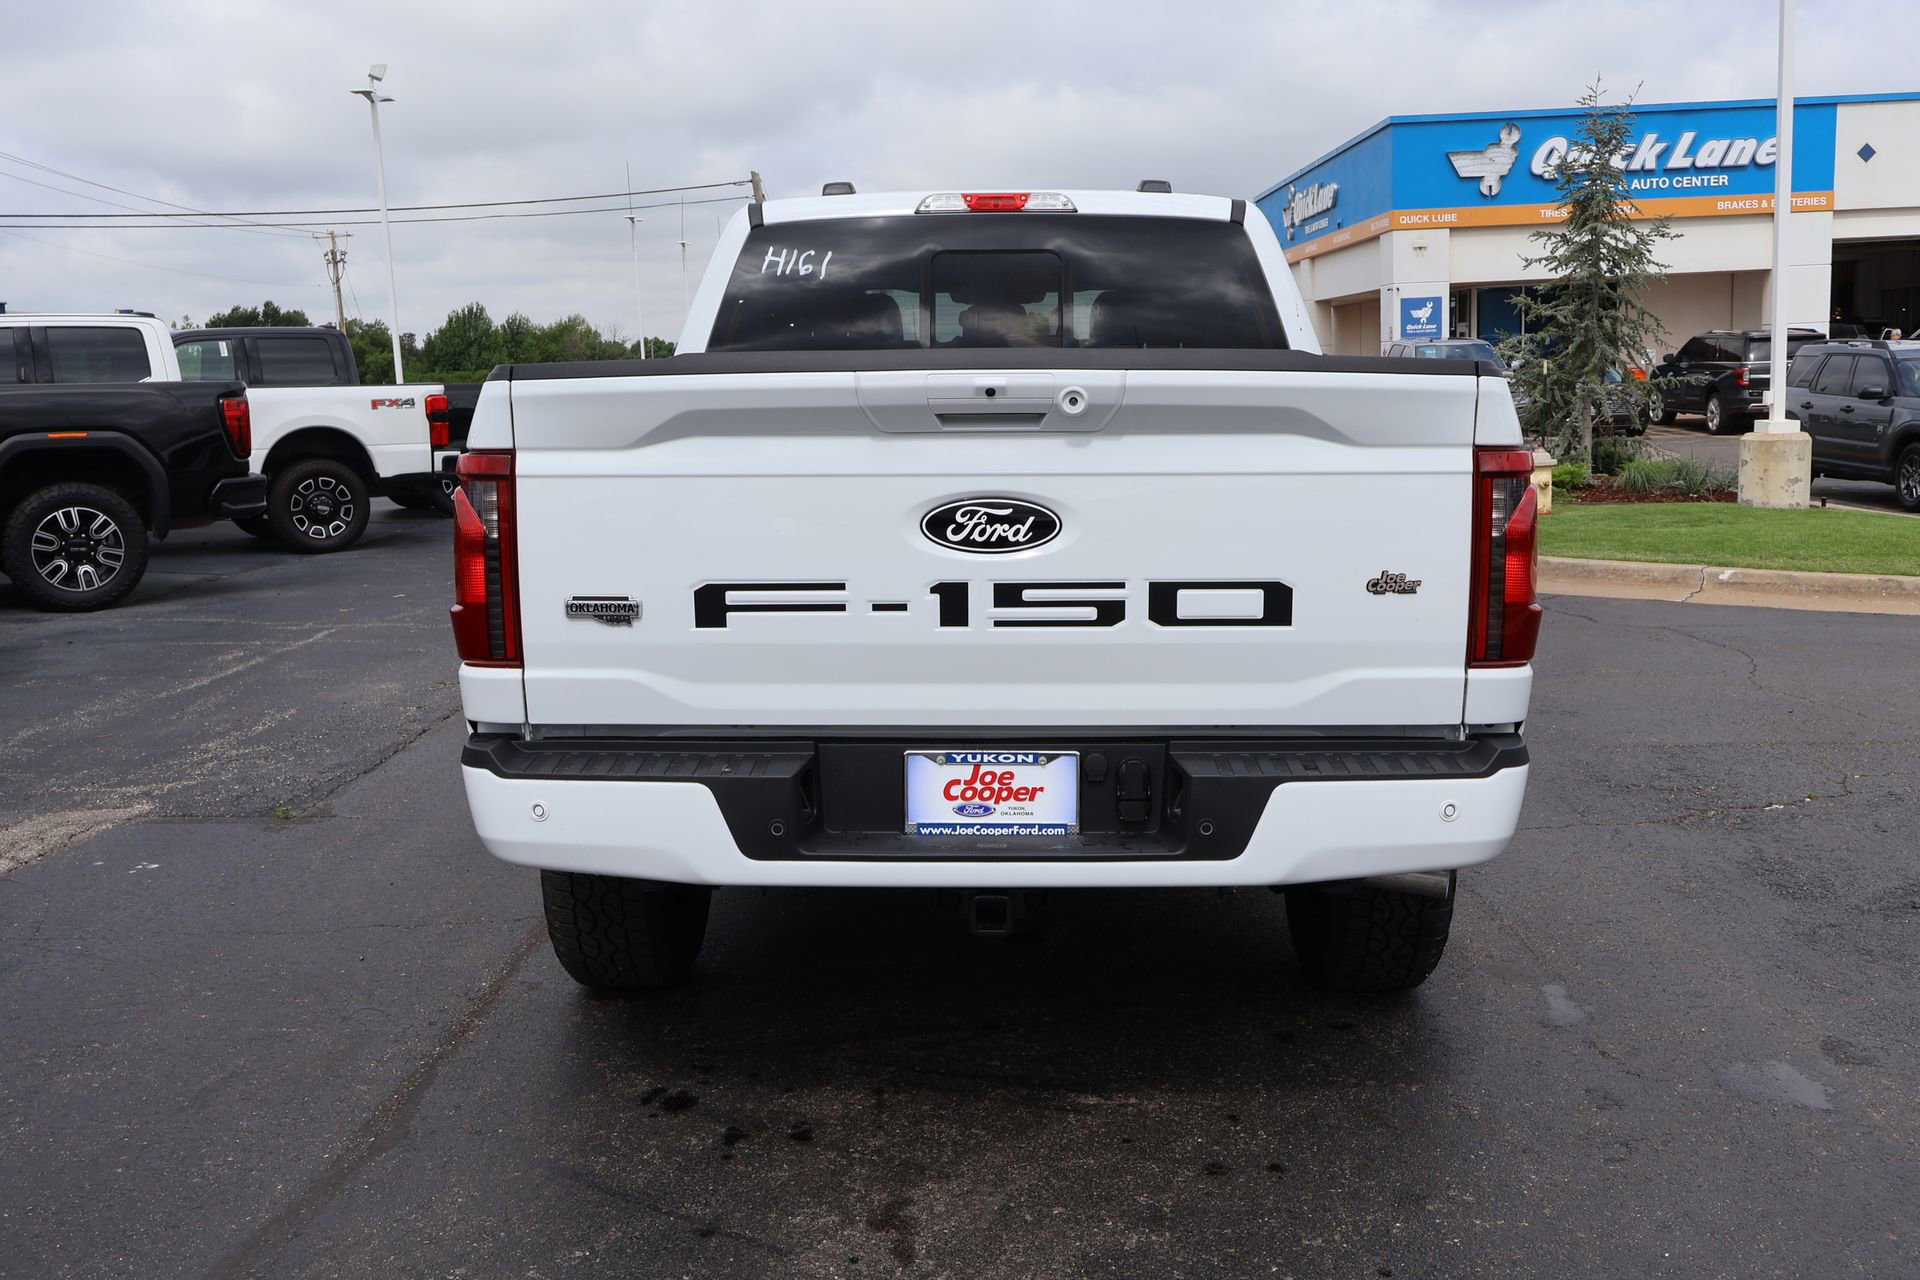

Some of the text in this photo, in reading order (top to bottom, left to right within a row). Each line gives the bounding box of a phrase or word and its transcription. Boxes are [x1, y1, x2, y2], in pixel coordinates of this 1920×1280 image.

[1531, 131, 1776, 179] Quck Lane
[1631, 177, 1669, 190] AUTO
[1672, 175, 1728, 188] CENTER
[1717, 199, 1759, 210] BRAKES
[1761, 200, 1768, 208] &
[1399, 213, 1458, 224] QUICK LUBE
[1540, 208, 1568, 218] TIRES
[761, 246, 833, 280] H161
[371, 398, 415, 410] FX4
[946, 506, 1033, 543] Ford
[1379, 570, 1407, 583] Joe
[1366, 578, 1422, 594] Cooper
[569, 602, 635, 613] OKLAHOMA
[693, 580, 1294, 628] F-150
[951, 753, 1034, 763] YUKON
[963, 764, 1014, 786] Joe
[943, 779, 1044, 805] Cooper
[919, 825, 1065, 836] www.JoeCooperFord.com
